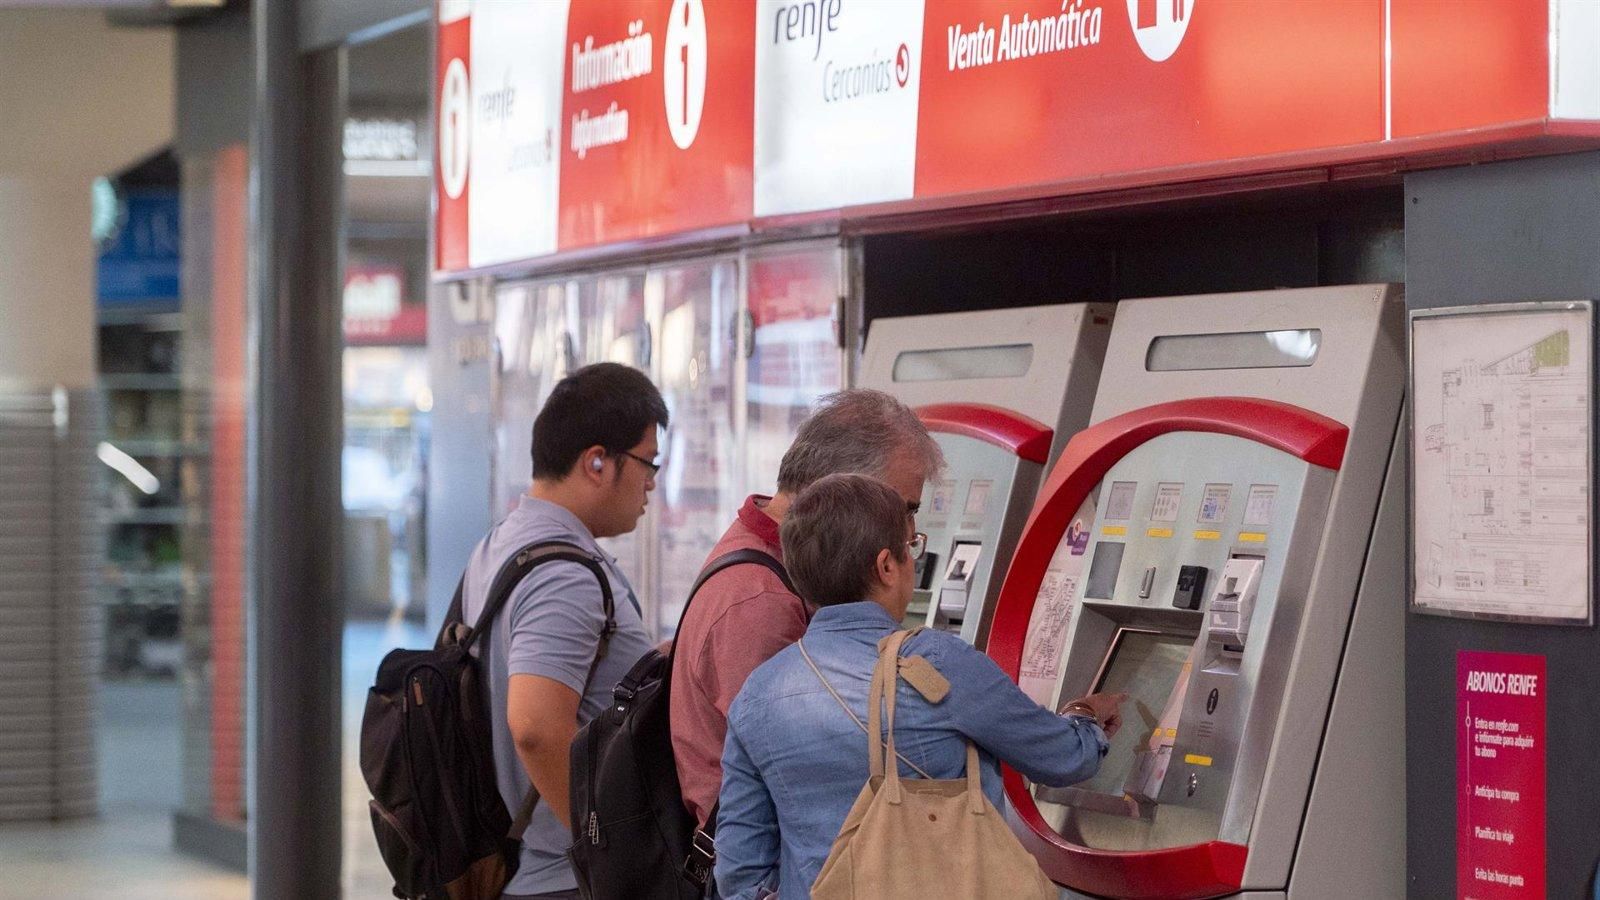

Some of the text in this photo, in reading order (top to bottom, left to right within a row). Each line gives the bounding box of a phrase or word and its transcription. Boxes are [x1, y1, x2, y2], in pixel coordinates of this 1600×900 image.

[774, 0, 841, 61] renfe
[948, 0, 1103, 72] Venta Automática
[572, 18, 652, 93] Información
[823, 47, 891, 103] Cercanías
[571, 100, 629, 160] Information
[1466, 671, 1538, 696] ABONOS RENFE
[1475, 717, 1519, 734] Entra en renfe.com
[1475, 745, 1497, 758] tu abono
[1502, 736, 1514, 748] para
[1495, 788, 1501, 799] tu
[1501, 790, 1520, 804] compra
[1475, 826, 1515, 846] Planifica tu viaje
[1475, 867, 1524, 887] Evita las horas punta
